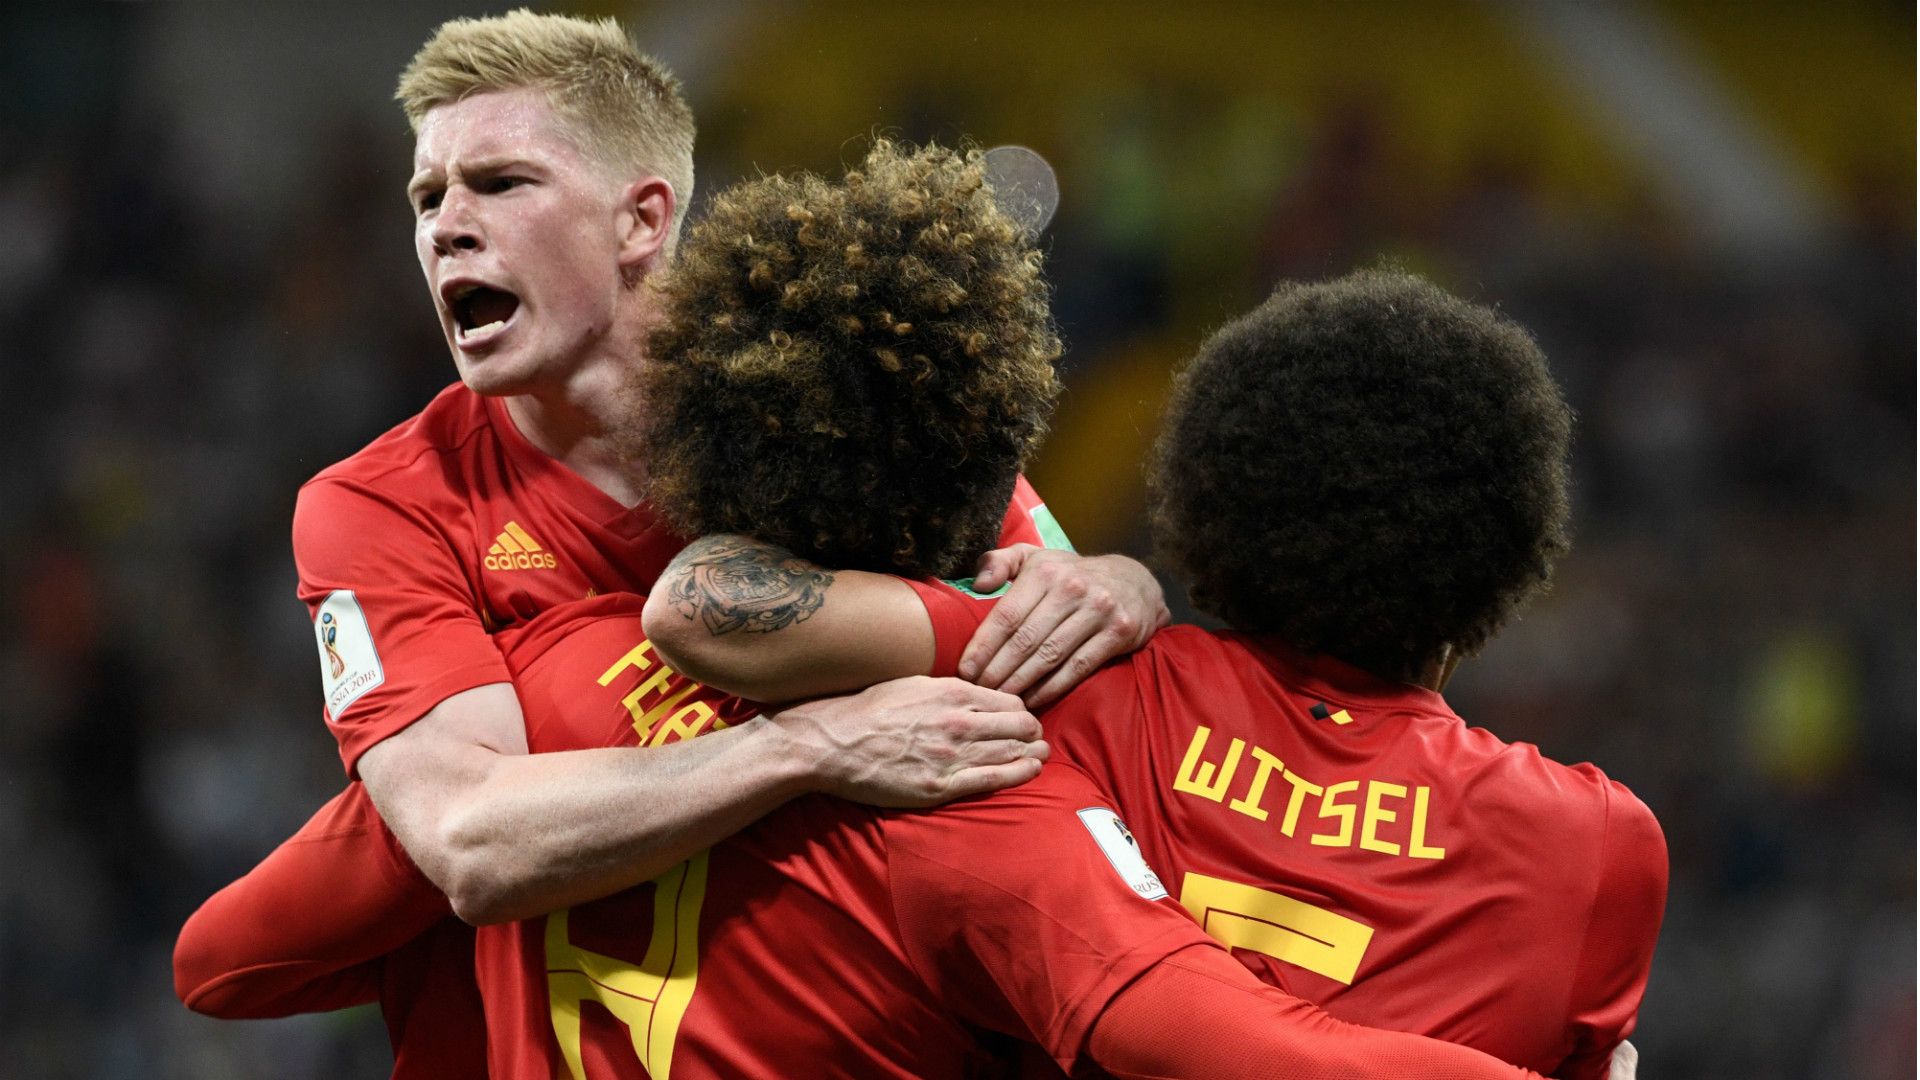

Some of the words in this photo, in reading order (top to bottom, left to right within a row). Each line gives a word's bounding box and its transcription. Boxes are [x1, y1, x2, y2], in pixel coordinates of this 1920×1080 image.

[484, 551, 556, 570] adidas
[351, 670, 376, 692] 2018
[1173, 725, 1446, 860] WITSEL
[1133, 880, 1160, 893] RUS
